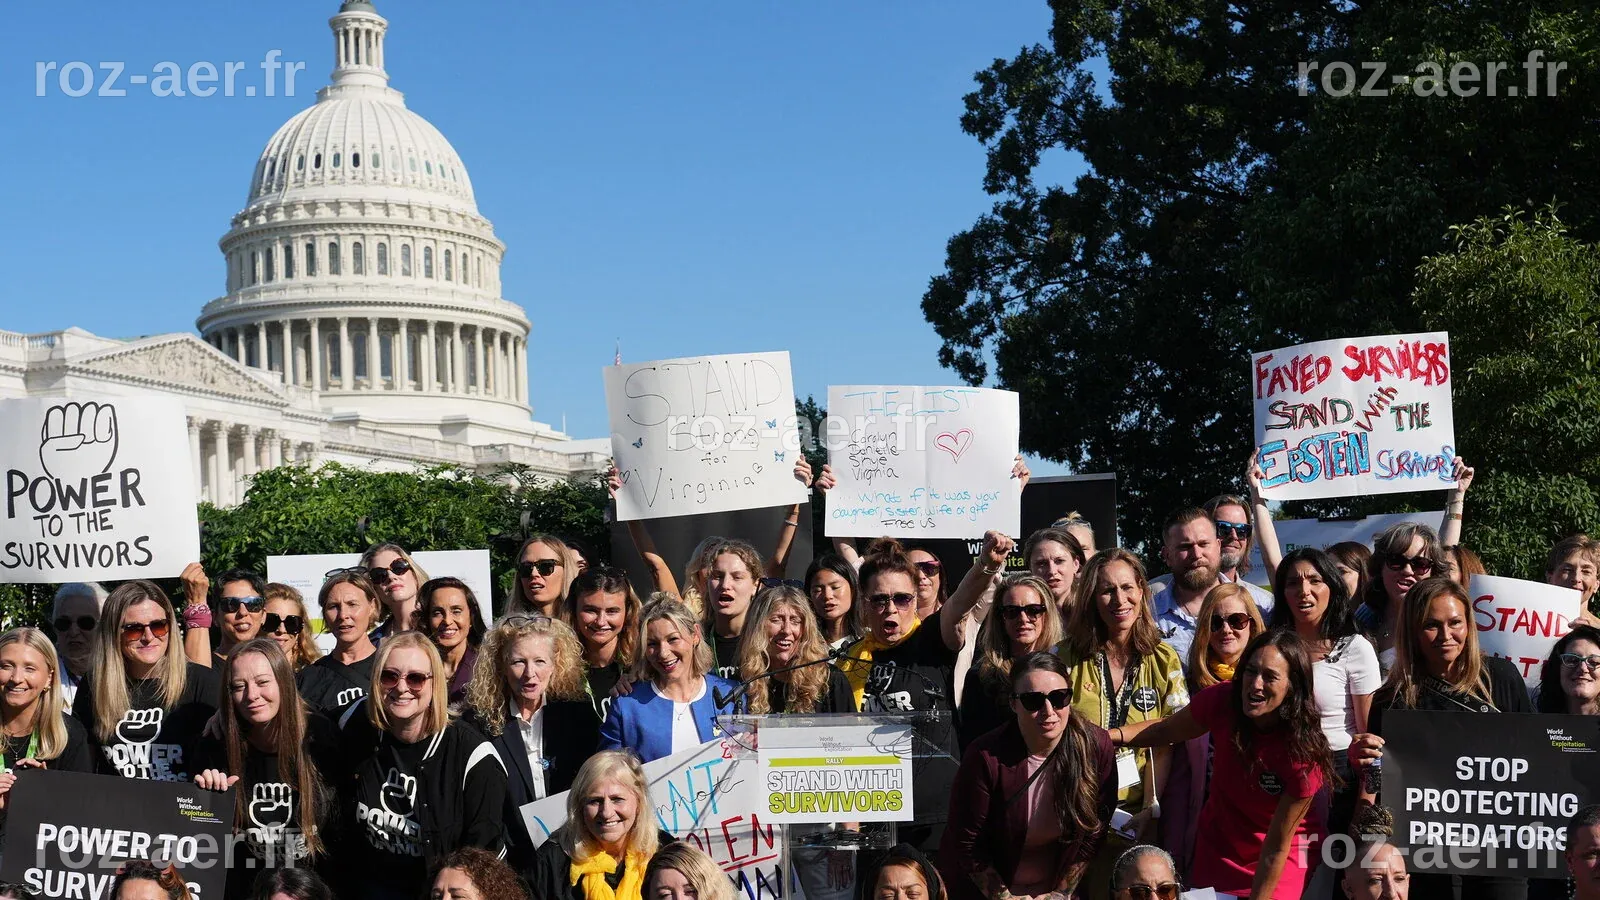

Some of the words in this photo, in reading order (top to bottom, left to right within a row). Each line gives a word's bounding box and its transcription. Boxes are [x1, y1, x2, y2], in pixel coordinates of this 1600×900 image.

[1255, 353, 1333, 399] FAYED
[625, 360, 782, 426] STAND
[1265, 397, 1354, 431] STAND
[1390, 401, 1433, 432] THE
[851, 428, 897, 447] Carolyn
[701, 452, 728, 465] for
[7, 468, 146, 518] POWER
[635, 467, 755, 507] Virginia
[33, 513, 63, 537] TO
[69, 509, 113, 535] THE
[1, 536, 153, 570] SURVIVORS
[1472, 595, 1570, 638] STAND
[1551, 740, 1586, 748] Exploitation
[767, 769, 842, 791] STAND
[844, 769, 904, 790] WITH
[1456, 756, 1529, 782] STOP
[180, 809, 214, 818] Exploitation
[768, 790, 904, 814] SURVIVORS
[1405, 788, 1579, 818] PROTECTING
[36, 823, 150, 860] POWER
[153, 834, 199, 864] TO
[1408, 820, 1568, 851] PREDATORS
